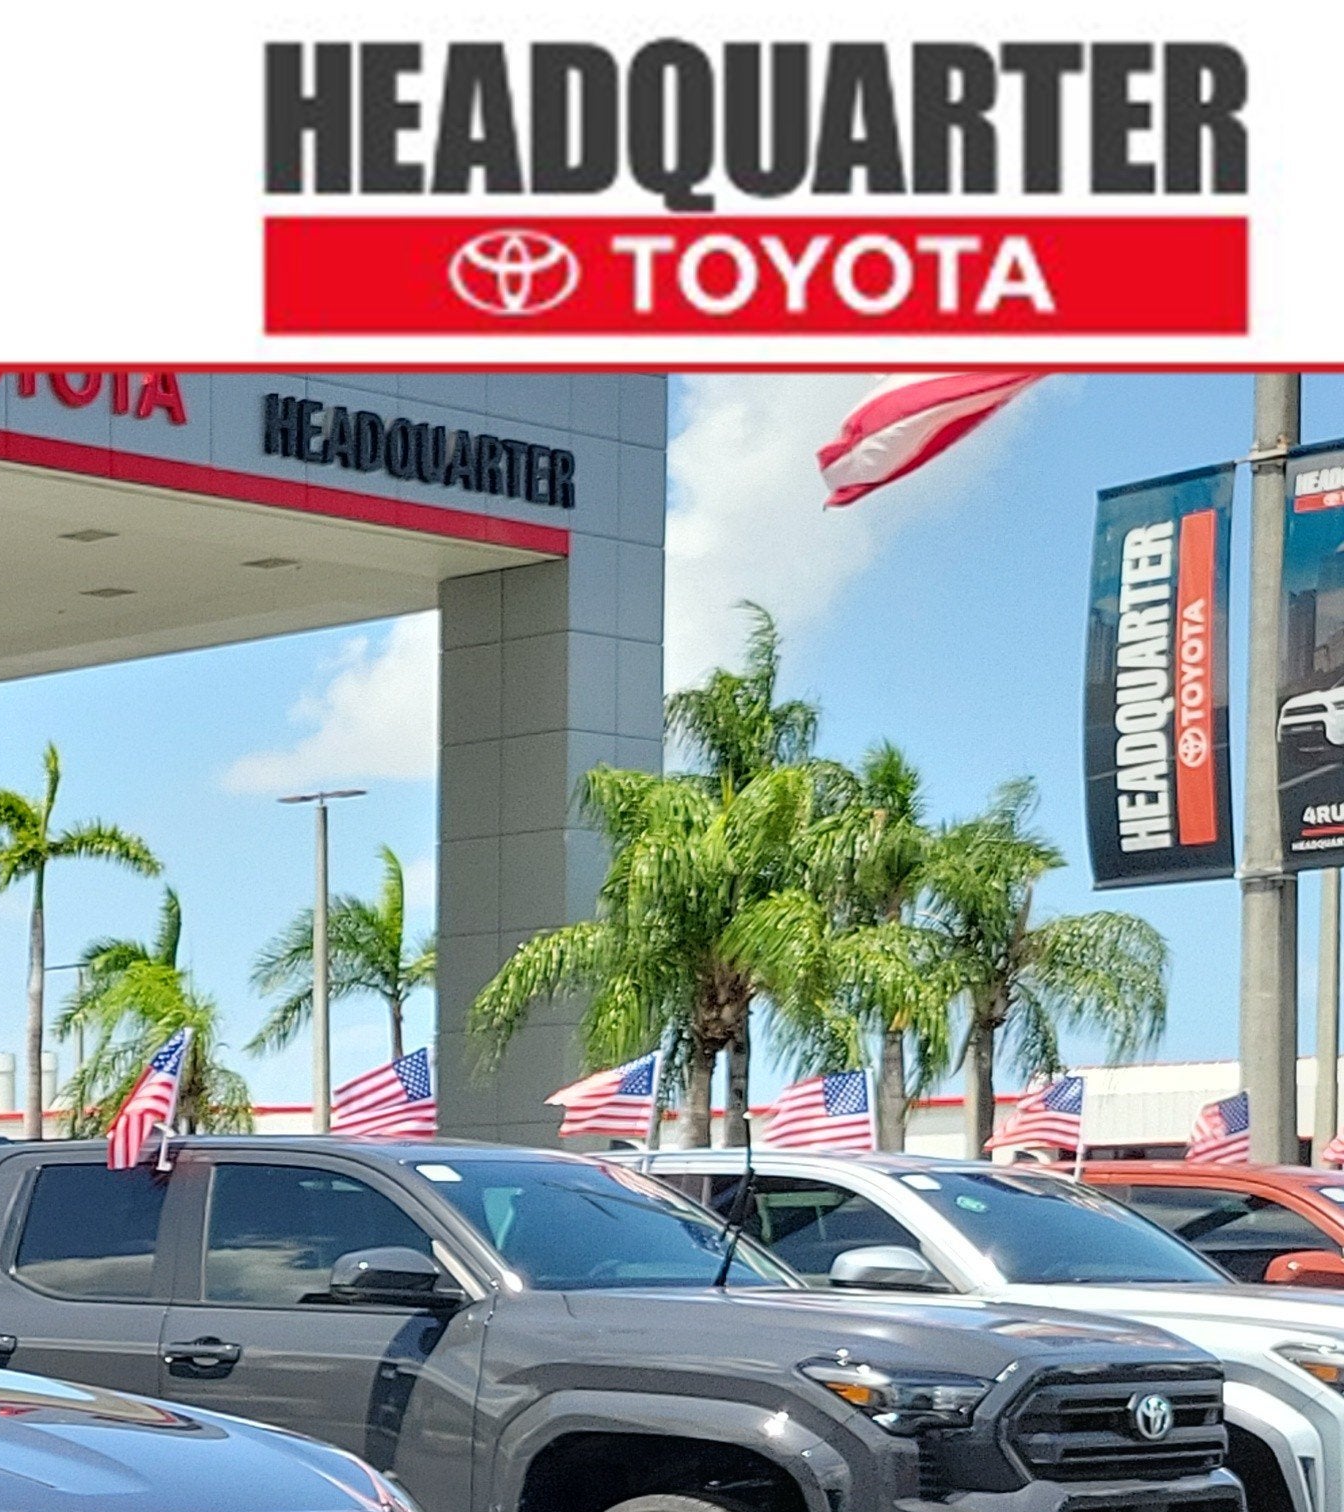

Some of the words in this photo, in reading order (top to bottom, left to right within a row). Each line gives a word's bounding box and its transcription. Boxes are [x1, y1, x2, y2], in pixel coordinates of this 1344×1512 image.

[263, 392, 576, 509] HEADQUARTER
[1114, 520, 1175, 852] HEADQUARTER
[1180, 598, 1208, 727] TOYOTA
